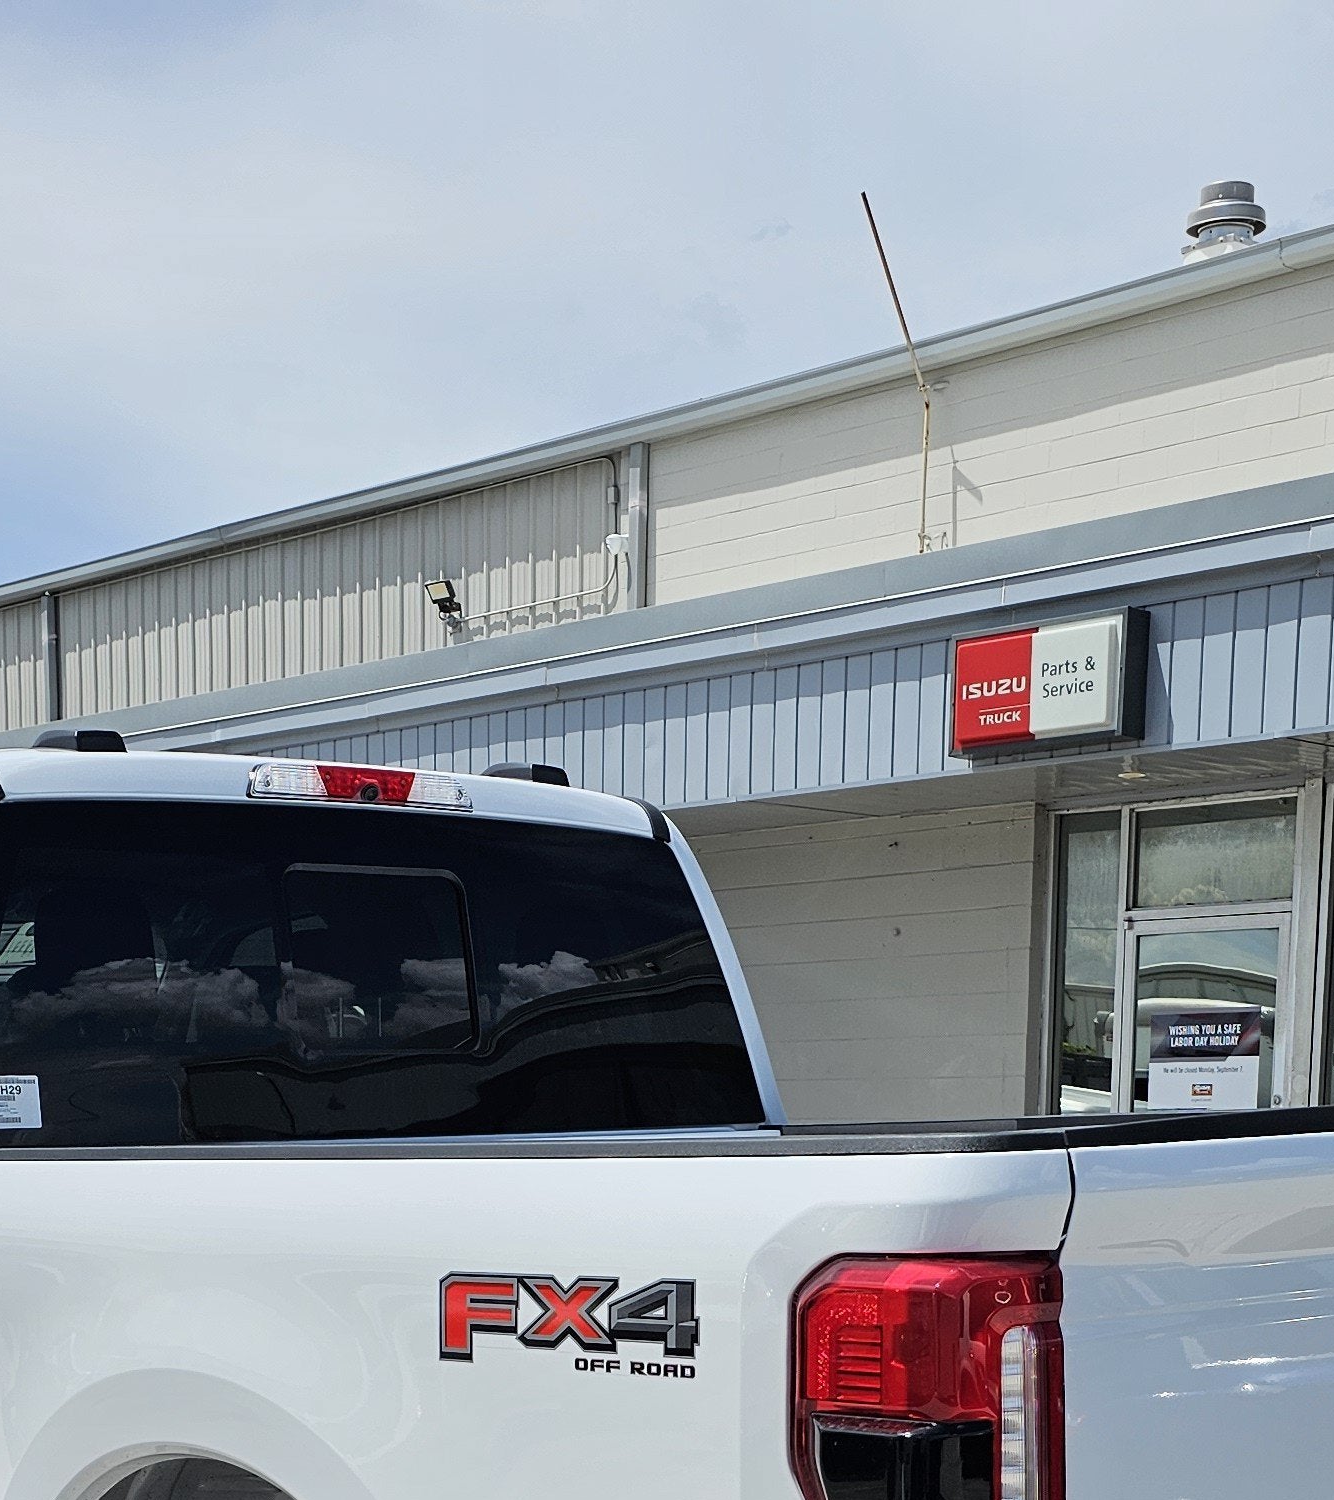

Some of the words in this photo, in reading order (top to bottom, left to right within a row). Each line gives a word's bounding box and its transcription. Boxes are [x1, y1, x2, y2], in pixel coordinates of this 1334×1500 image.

[1041, 658, 1078, 678] Parts
[1084, 655, 1096, 672] &
[962, 675, 1026, 700] ISUZU
[1042, 677, 1095, 699] Service
[978, 709, 1021, 726] TRUCK
[1169, 1024, 1200, 1036] WISHING
[1201, 1024, 1216, 1035] YOU
[1217, 1024, 1222, 1034] A
[1223, 1023, 1242, 1034] SAFE
[1170, 1036, 1193, 1048] LABOR
[1194, 1036, 1208, 1047] DAY
[1209, 1035, 1240, 1046] HOLIDAY
[438, 1270, 701, 1363] FX4
[574, 1357, 621, 1374] OFF
[629, 1360, 696, 1380] ROAD
